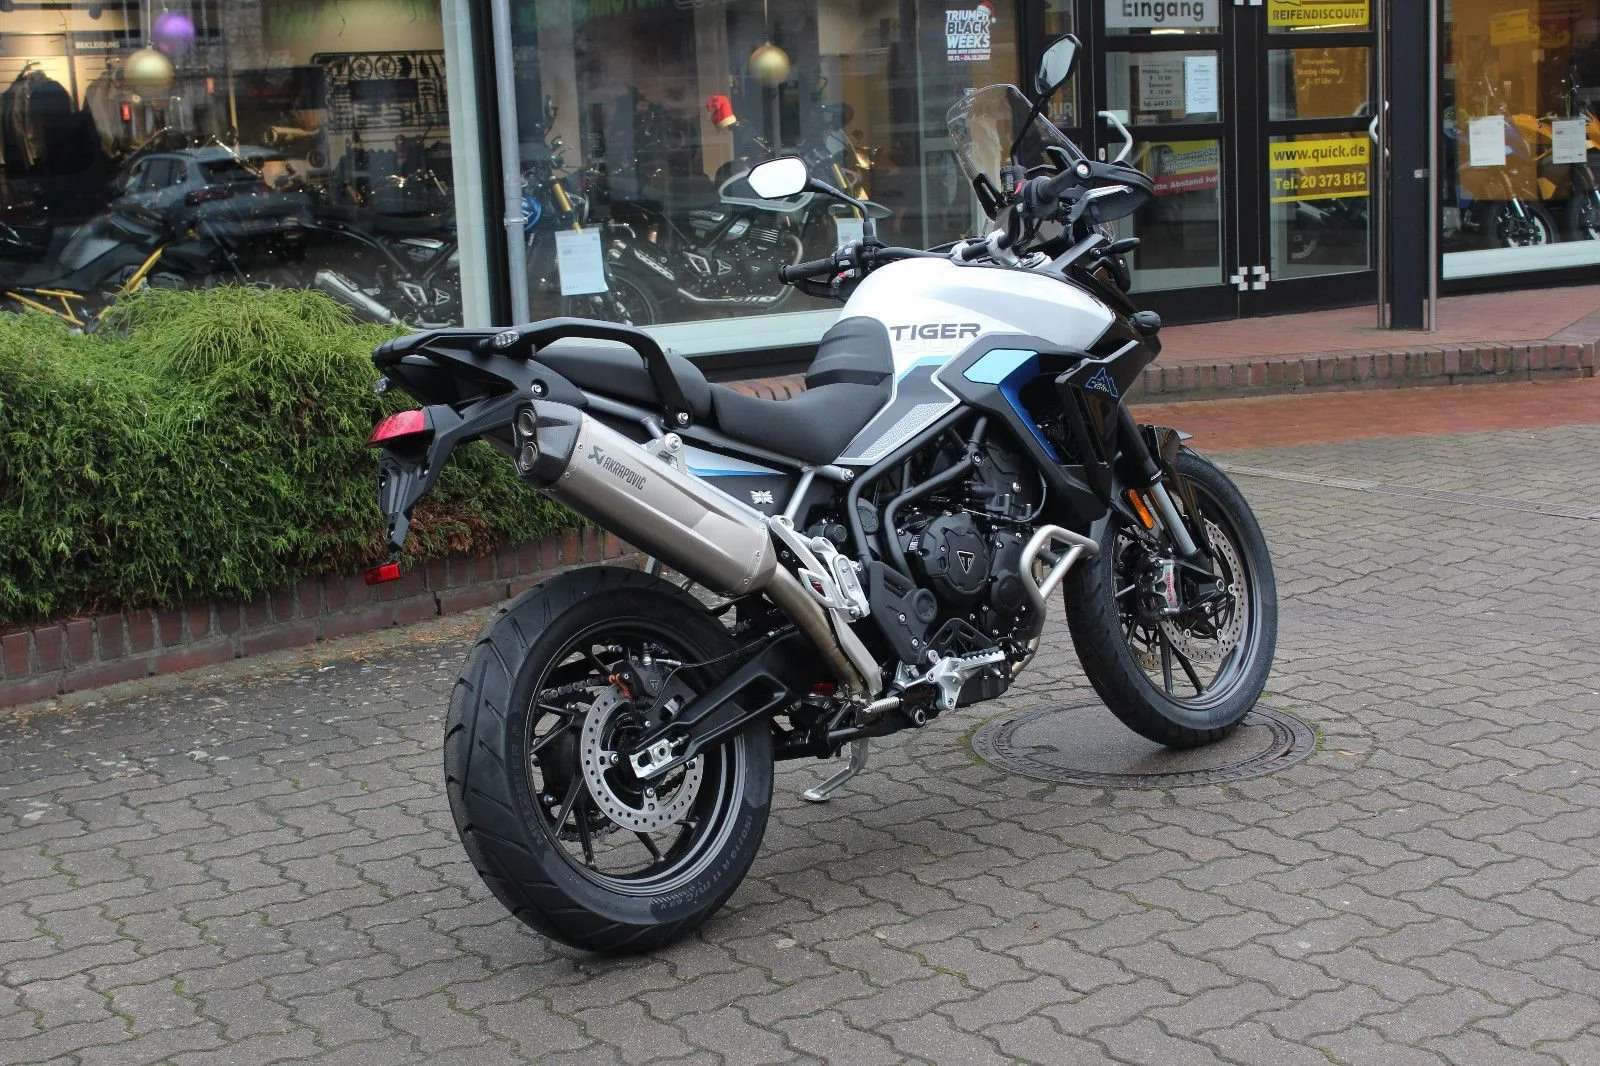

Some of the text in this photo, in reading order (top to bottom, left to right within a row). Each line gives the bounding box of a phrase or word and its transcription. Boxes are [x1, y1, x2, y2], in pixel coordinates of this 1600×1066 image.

[946, 10, 990, 21] TRIUMPH
[1122, 0, 1204, 22] Eingang
[1273, 9, 1366, 20] REIFENDISCOUNT
[946, 21, 990, 35] BLACK
[75, 41, 120, 49] BEKLEIDUNG
[946, 35, 991, 48] WEEKS
[1273, 144, 1366, 162] www.quick.de
[1170, 177, 1204, 189] Abstand
[1275, 171, 1366, 191] Tel. 20 373 812
[889, 322, 982, 342] TIGER
